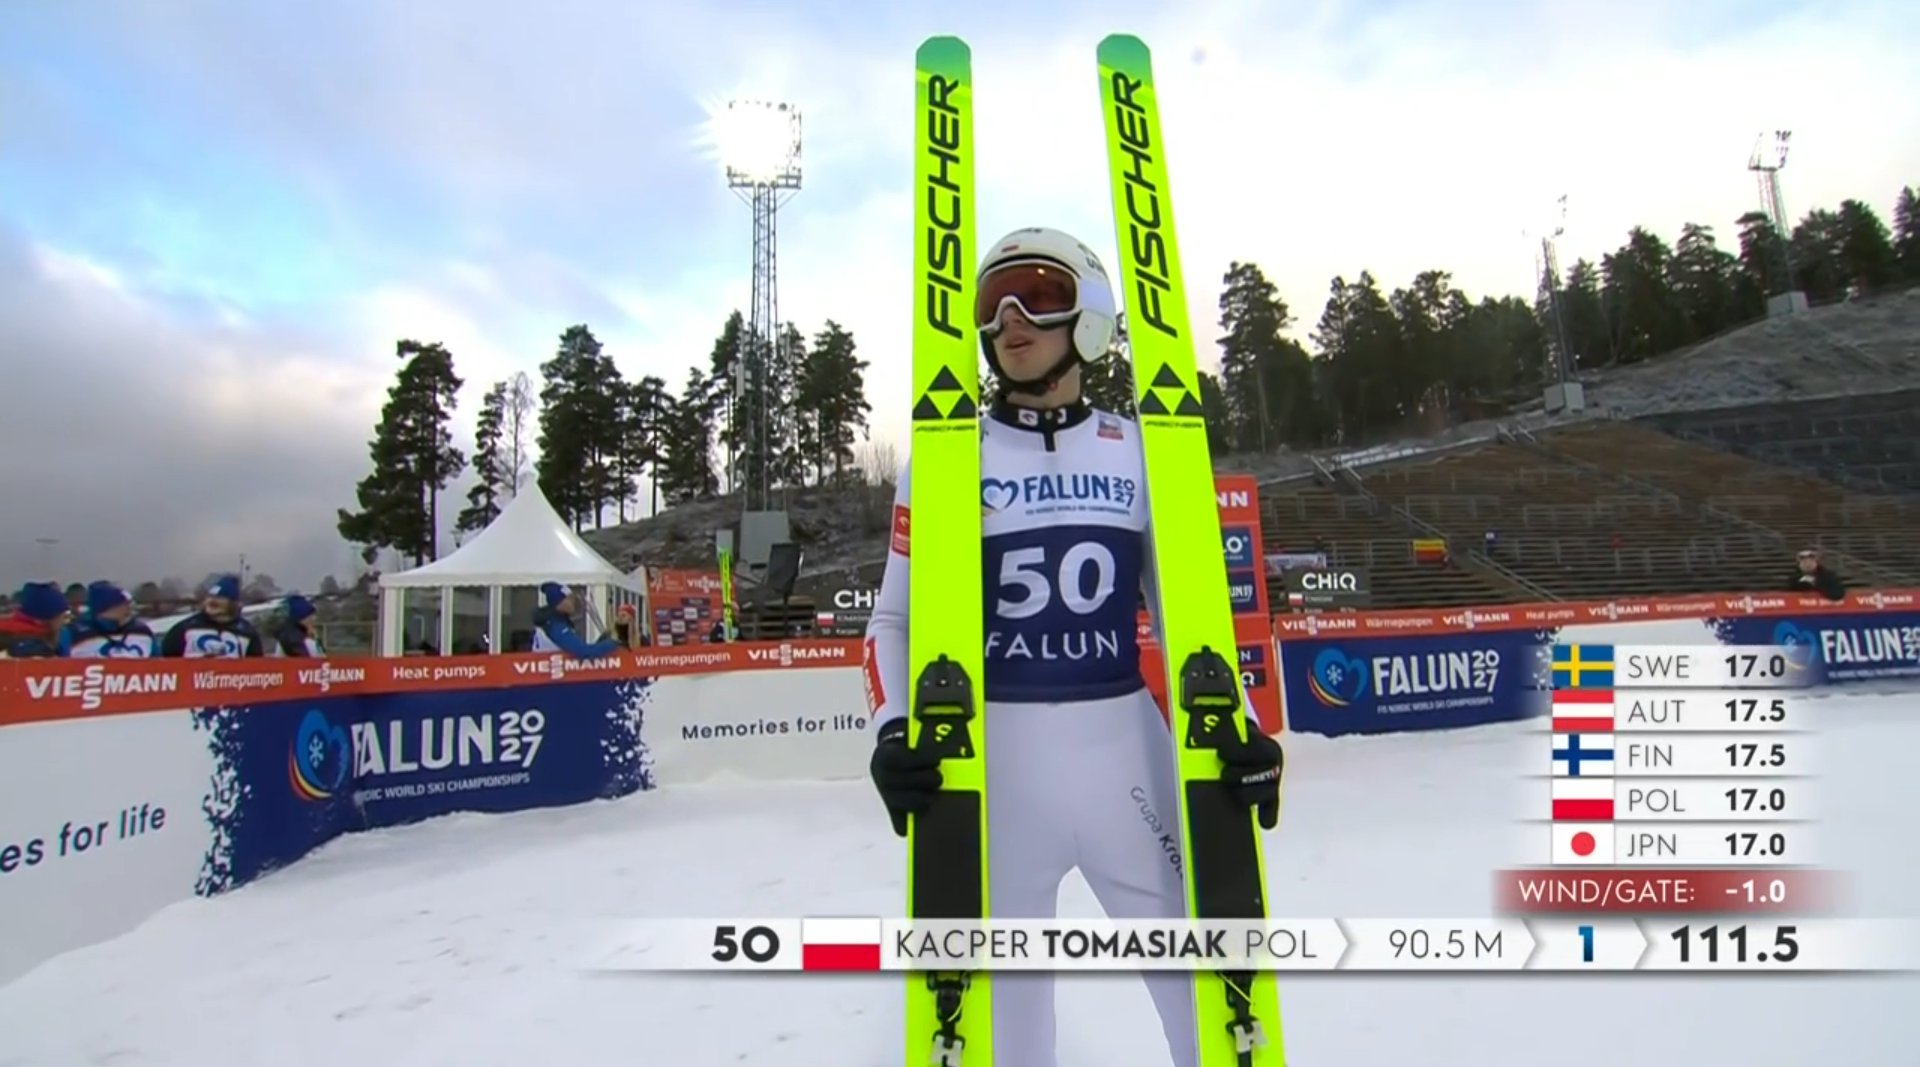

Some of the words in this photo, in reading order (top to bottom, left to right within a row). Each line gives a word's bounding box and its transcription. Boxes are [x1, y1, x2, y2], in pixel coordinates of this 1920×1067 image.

[927, 74, 963, 340] FISCHER
[1112, 72, 1178, 338] FISCHER
[1023, 474, 1110, 503] FALUN
[996, 541, 1116, 619] 50
[1302, 572, 1357, 591] CHiQ
[984, 630, 1119, 660] FALUN
[1820, 628, 1903, 664] FALUN
[26, 665, 177, 710] VIESSMANN
[194, 672, 283, 691] Wärmepumpen
[299, 662, 365, 692] VIESSMANN
[393, 665, 430, 679] Heat
[434, 664, 486, 681] pumps
[514, 654, 621, 680] VIESSMANN
[636, 651, 731, 668] Wärmepumpen
[747, 644, 846, 667] VIESSMANN
[1372, 652, 1471, 696] FALUN
[1472, 650, 1500, 667] 20
[1472, 670, 1500, 693] 27
[499, 709, 545, 736] 20
[682, 718, 789, 741] Memories
[797, 716, 826, 733] for
[834, 714, 866, 731] life
[499, 735, 543, 768] 27
[385, 784, 426, 799] WORLD
[427, 782, 446, 794] SKI
[447, 772, 531, 792] CHAMPIONSHIPS
[1130, 786, 1162, 833] Grupa
[59, 821, 109, 857] for
[119, 803, 166, 840] life
